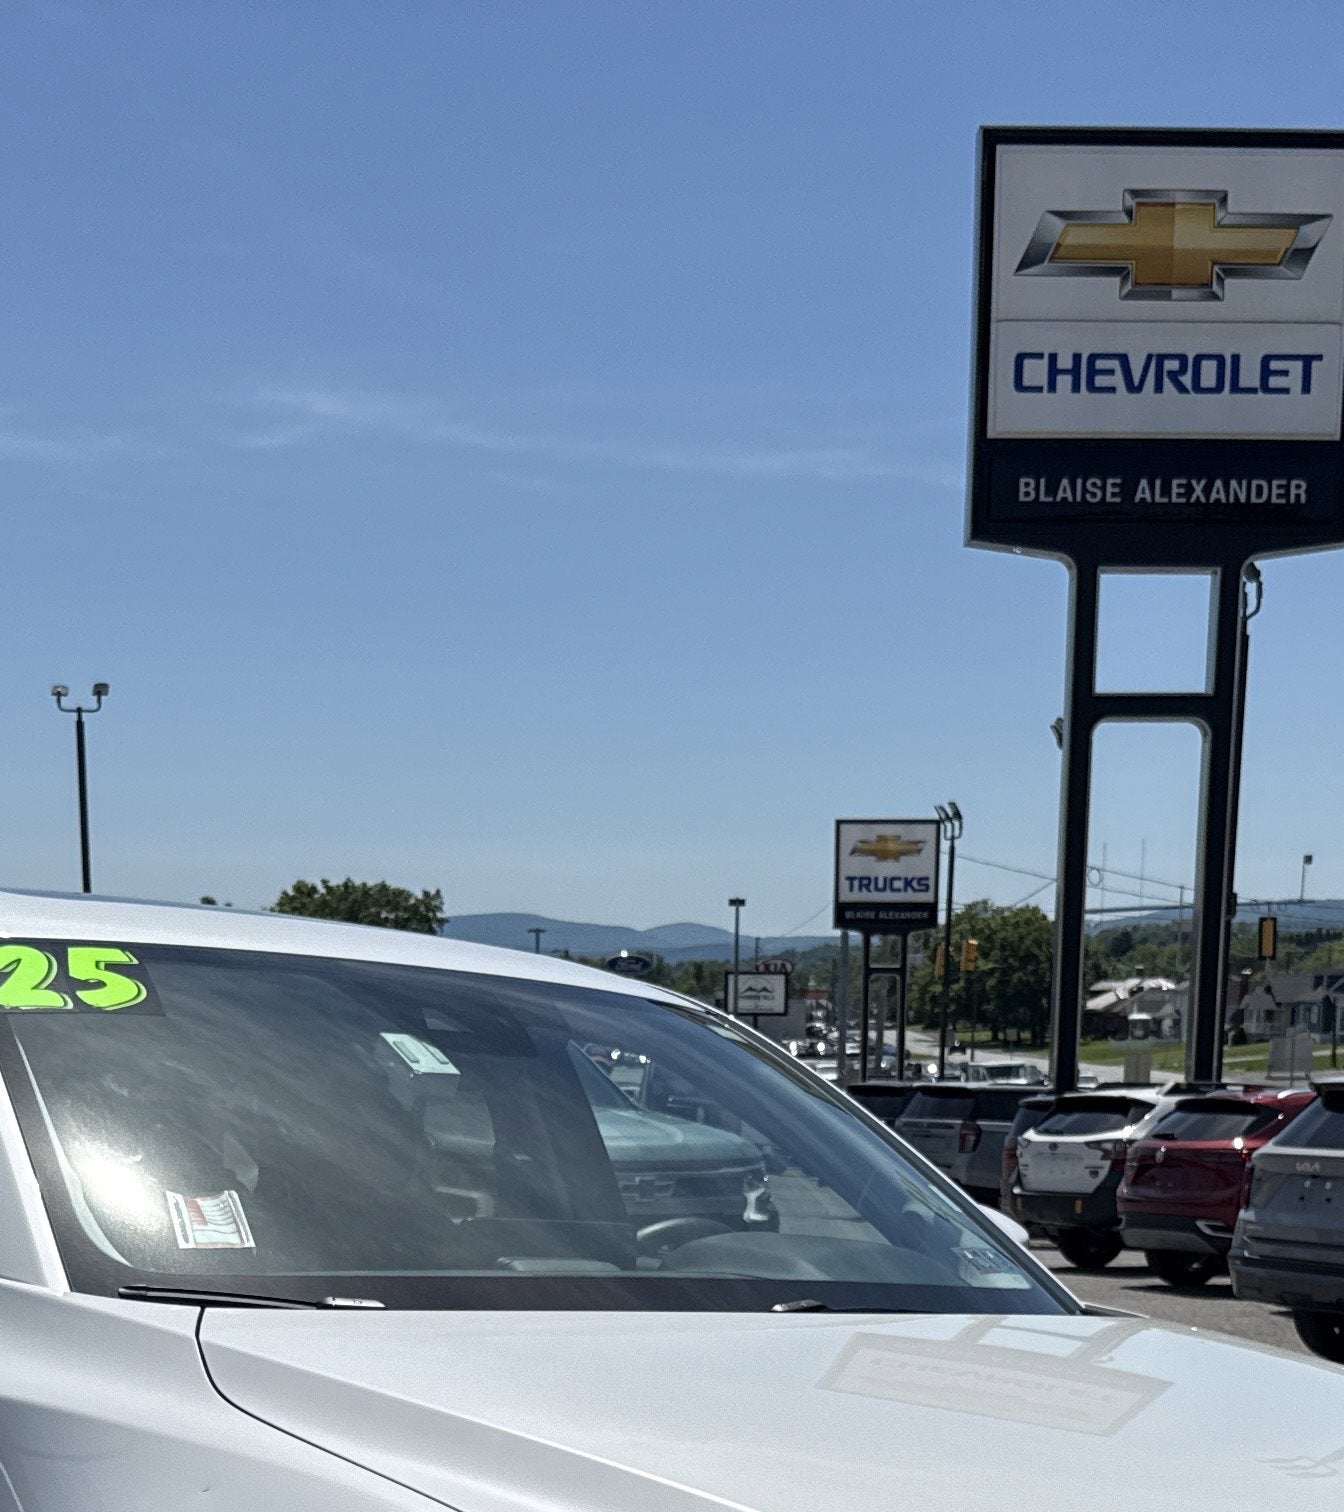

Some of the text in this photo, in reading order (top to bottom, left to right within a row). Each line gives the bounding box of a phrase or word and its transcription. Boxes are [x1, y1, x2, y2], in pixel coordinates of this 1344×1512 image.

[1012, 350, 1324, 397] CHEVROLET
[1018, 477, 1308, 505] BLAISE ALEXANDER
[845, 875, 931, 893] TRUCKS
